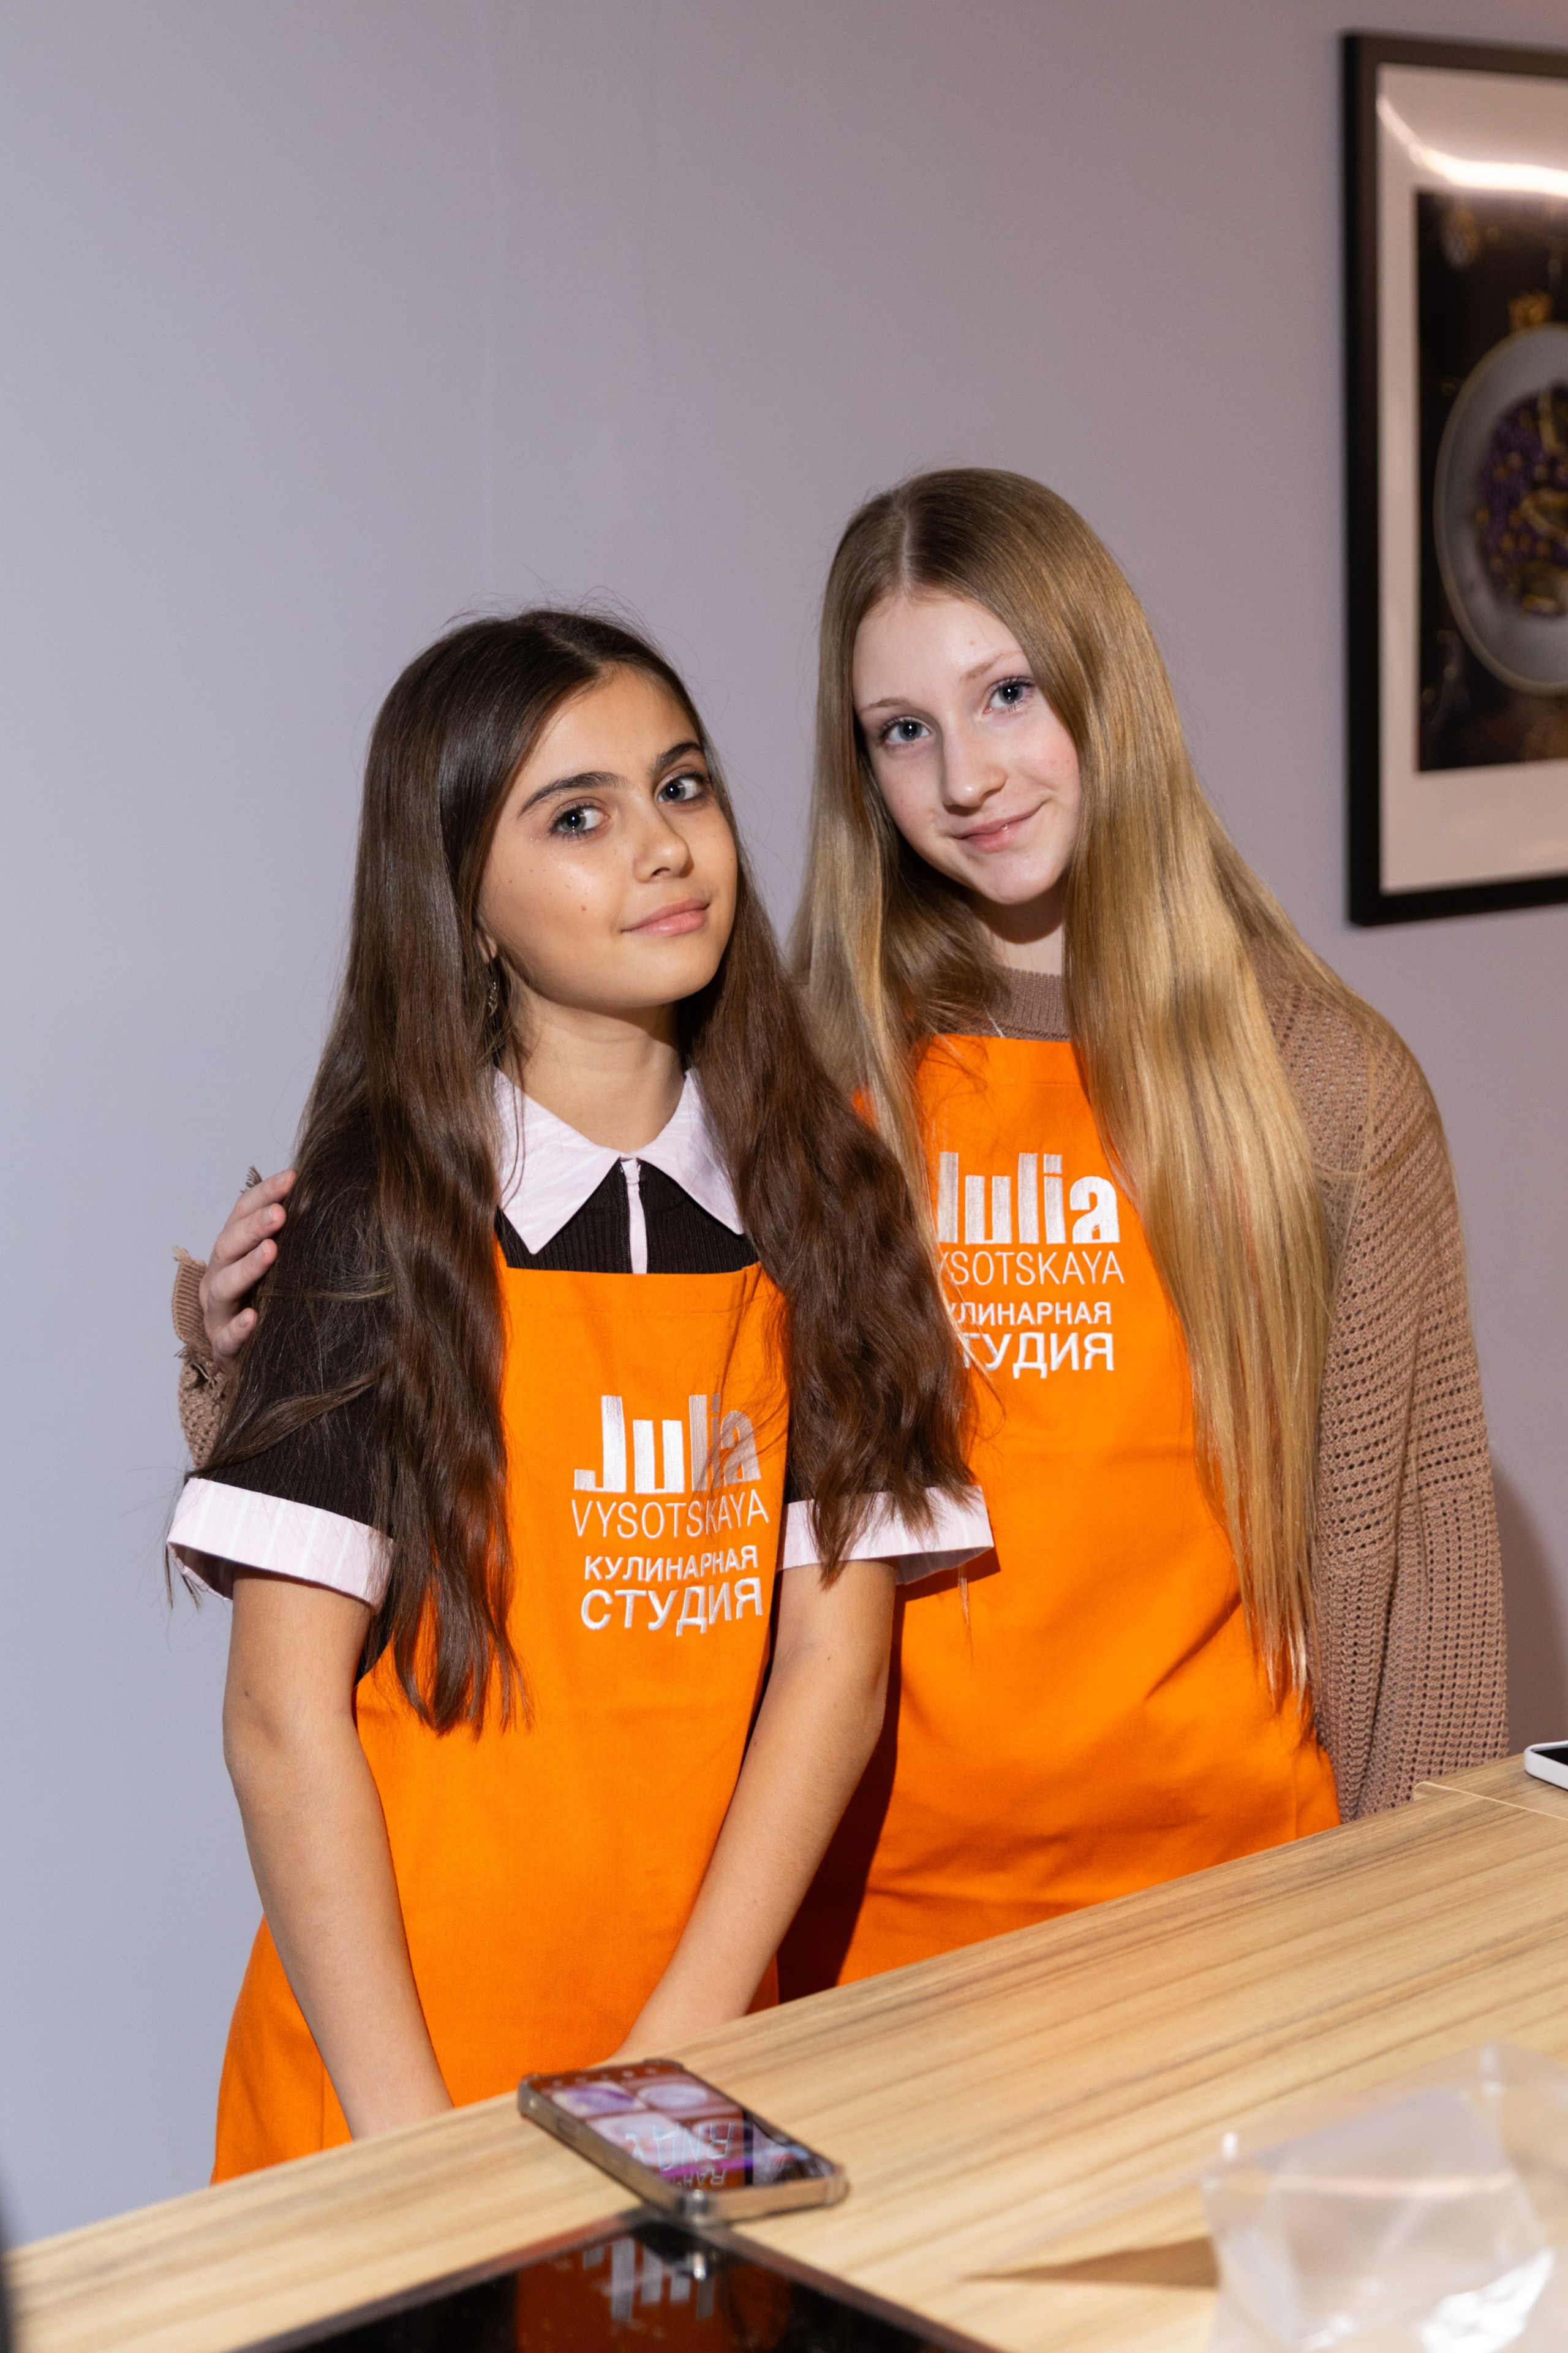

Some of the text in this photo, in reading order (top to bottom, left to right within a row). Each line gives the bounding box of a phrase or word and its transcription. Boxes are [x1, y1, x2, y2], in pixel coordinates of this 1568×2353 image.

[938, 1250, 1125, 1285] SOTSKAYA
[949, 1301, 1112, 1326] ЛИНАРНАЯ
[962, 1332, 1115, 1379] ТУДИЯ
[574, 1392, 761, 1494] Julia
[571, 1489, 770, 1539] VYSOTSKAYA
[584, 1545, 758, 1582] КУЛИНАРНАЯ
[581, 1577, 763, 1636] СТУДИЯ
